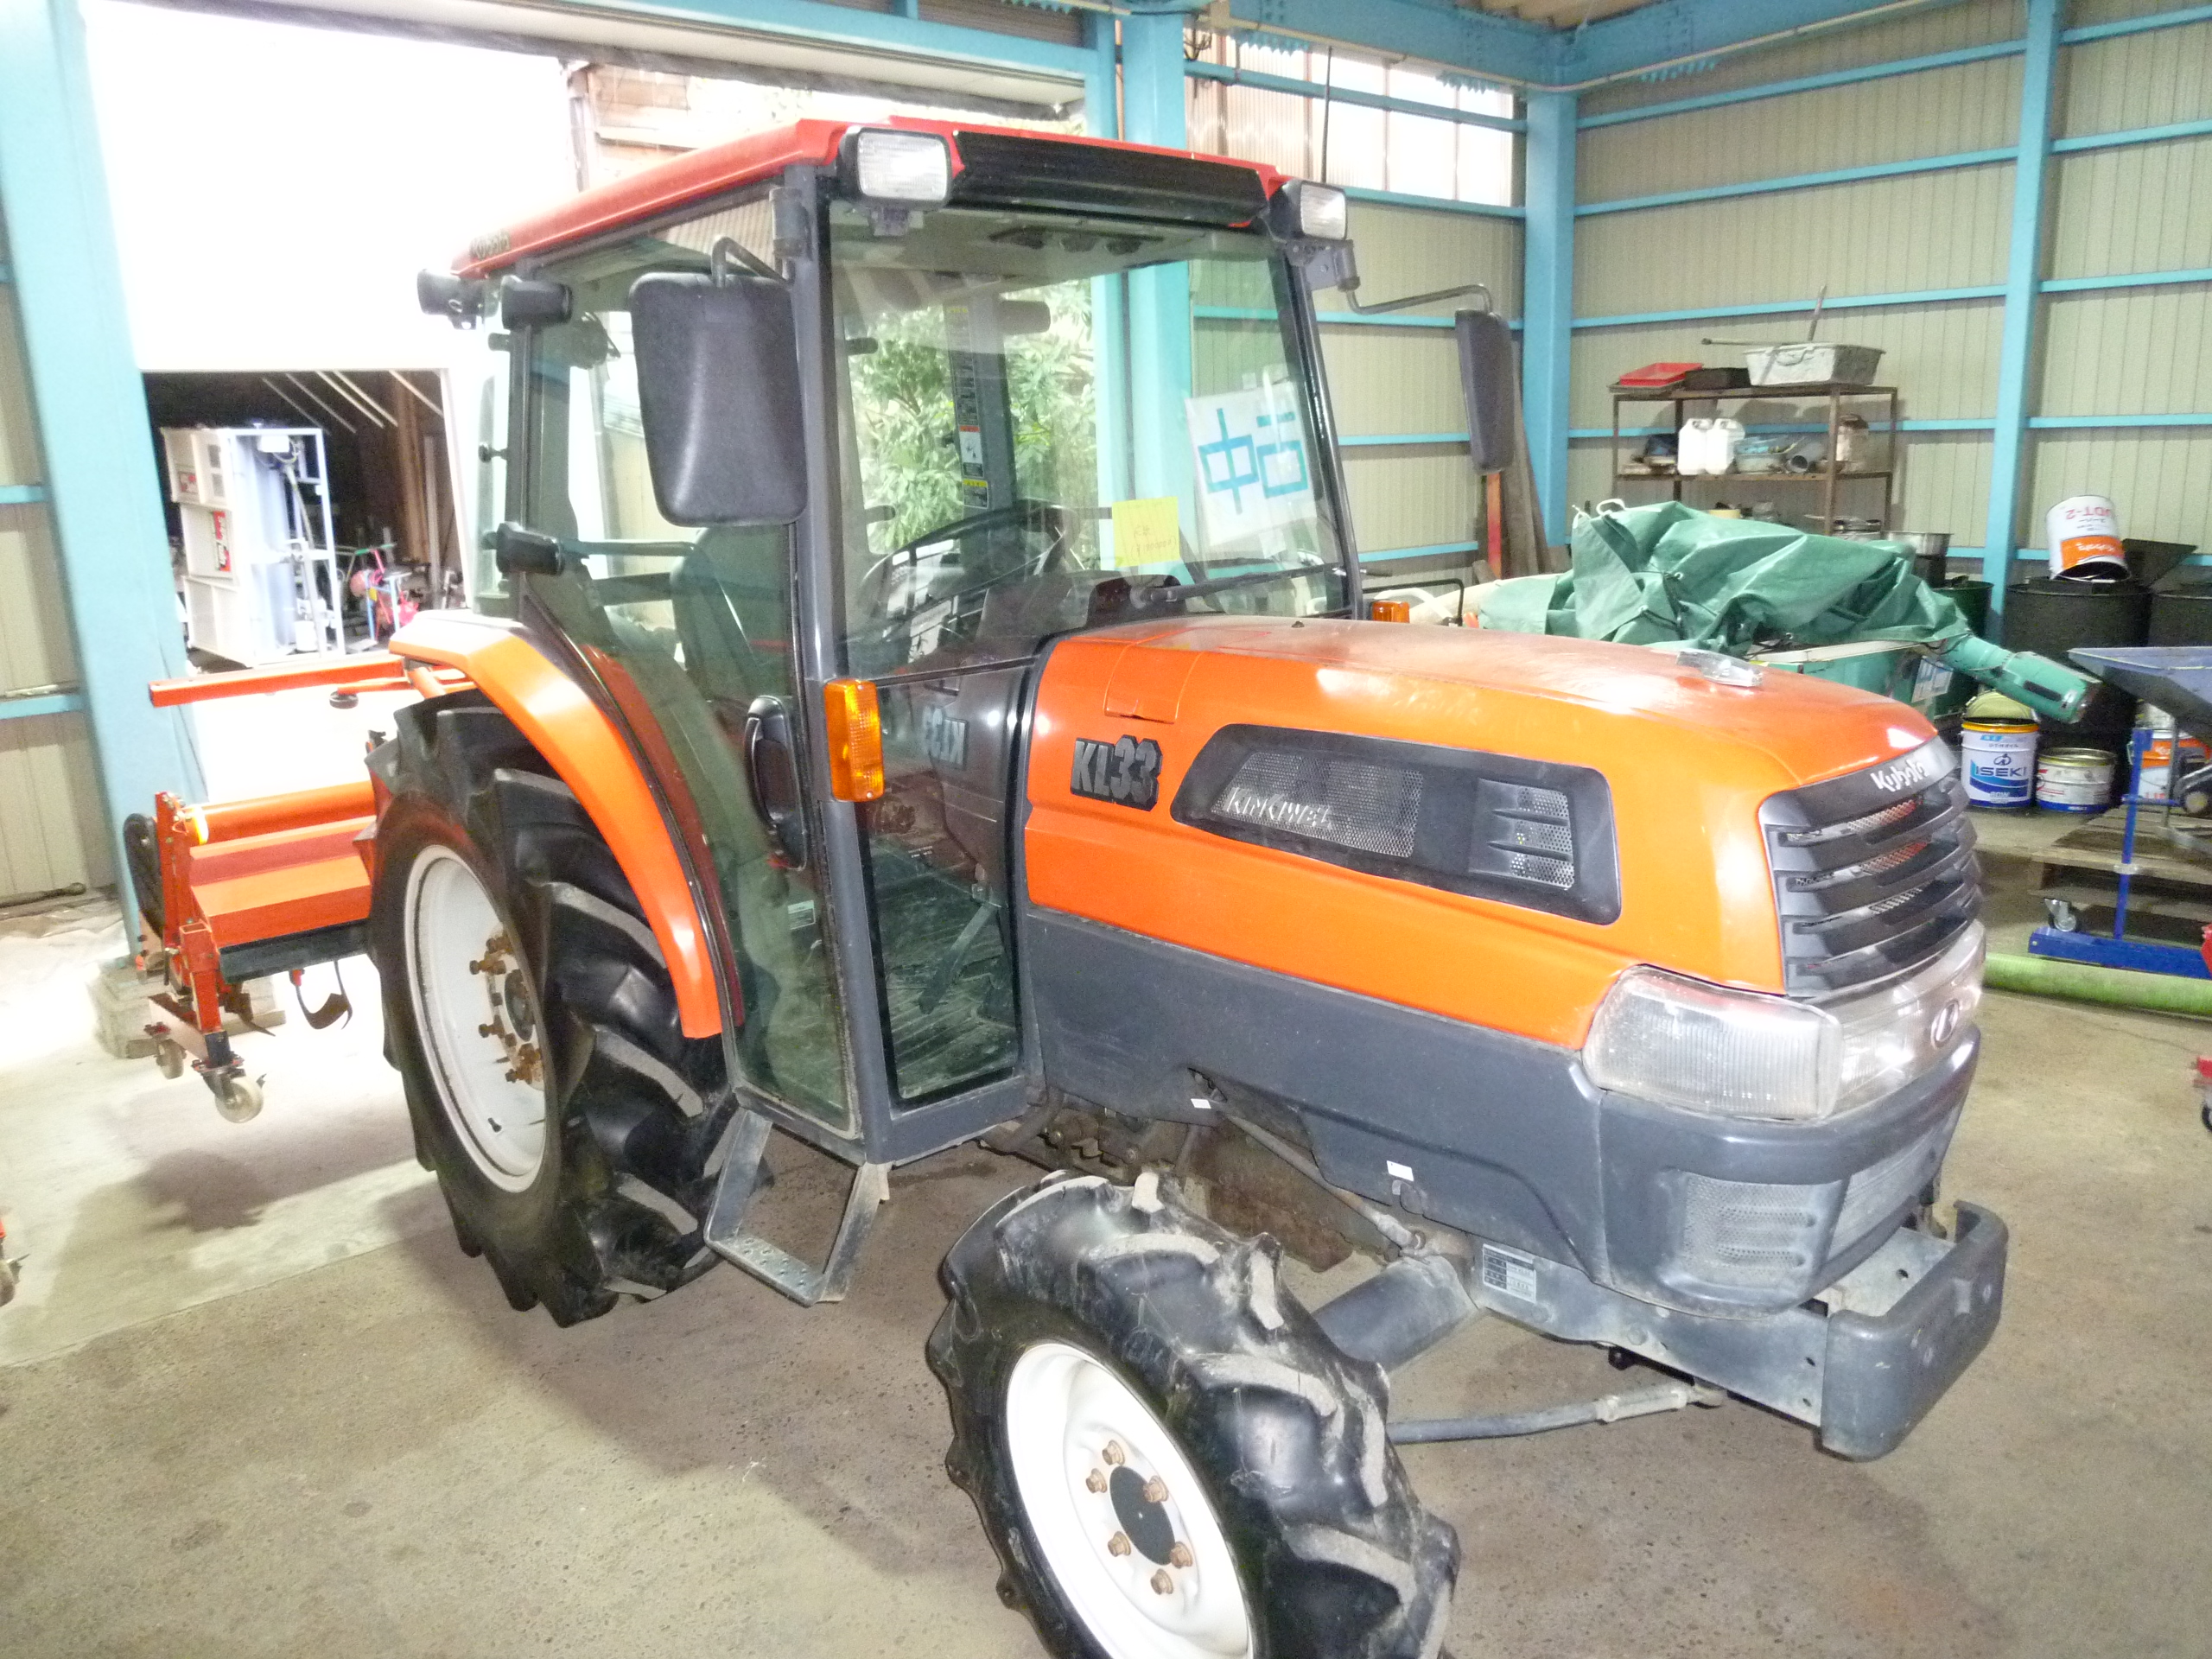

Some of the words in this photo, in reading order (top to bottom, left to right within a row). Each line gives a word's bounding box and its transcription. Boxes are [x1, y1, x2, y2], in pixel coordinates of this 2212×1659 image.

[1198, 408, 1308, 515] 中古
[1071, 735, 1161, 808] KL33
[1870, 760, 1929, 792] Kubota
[1975, 766, 2026, 778] ISEKI
